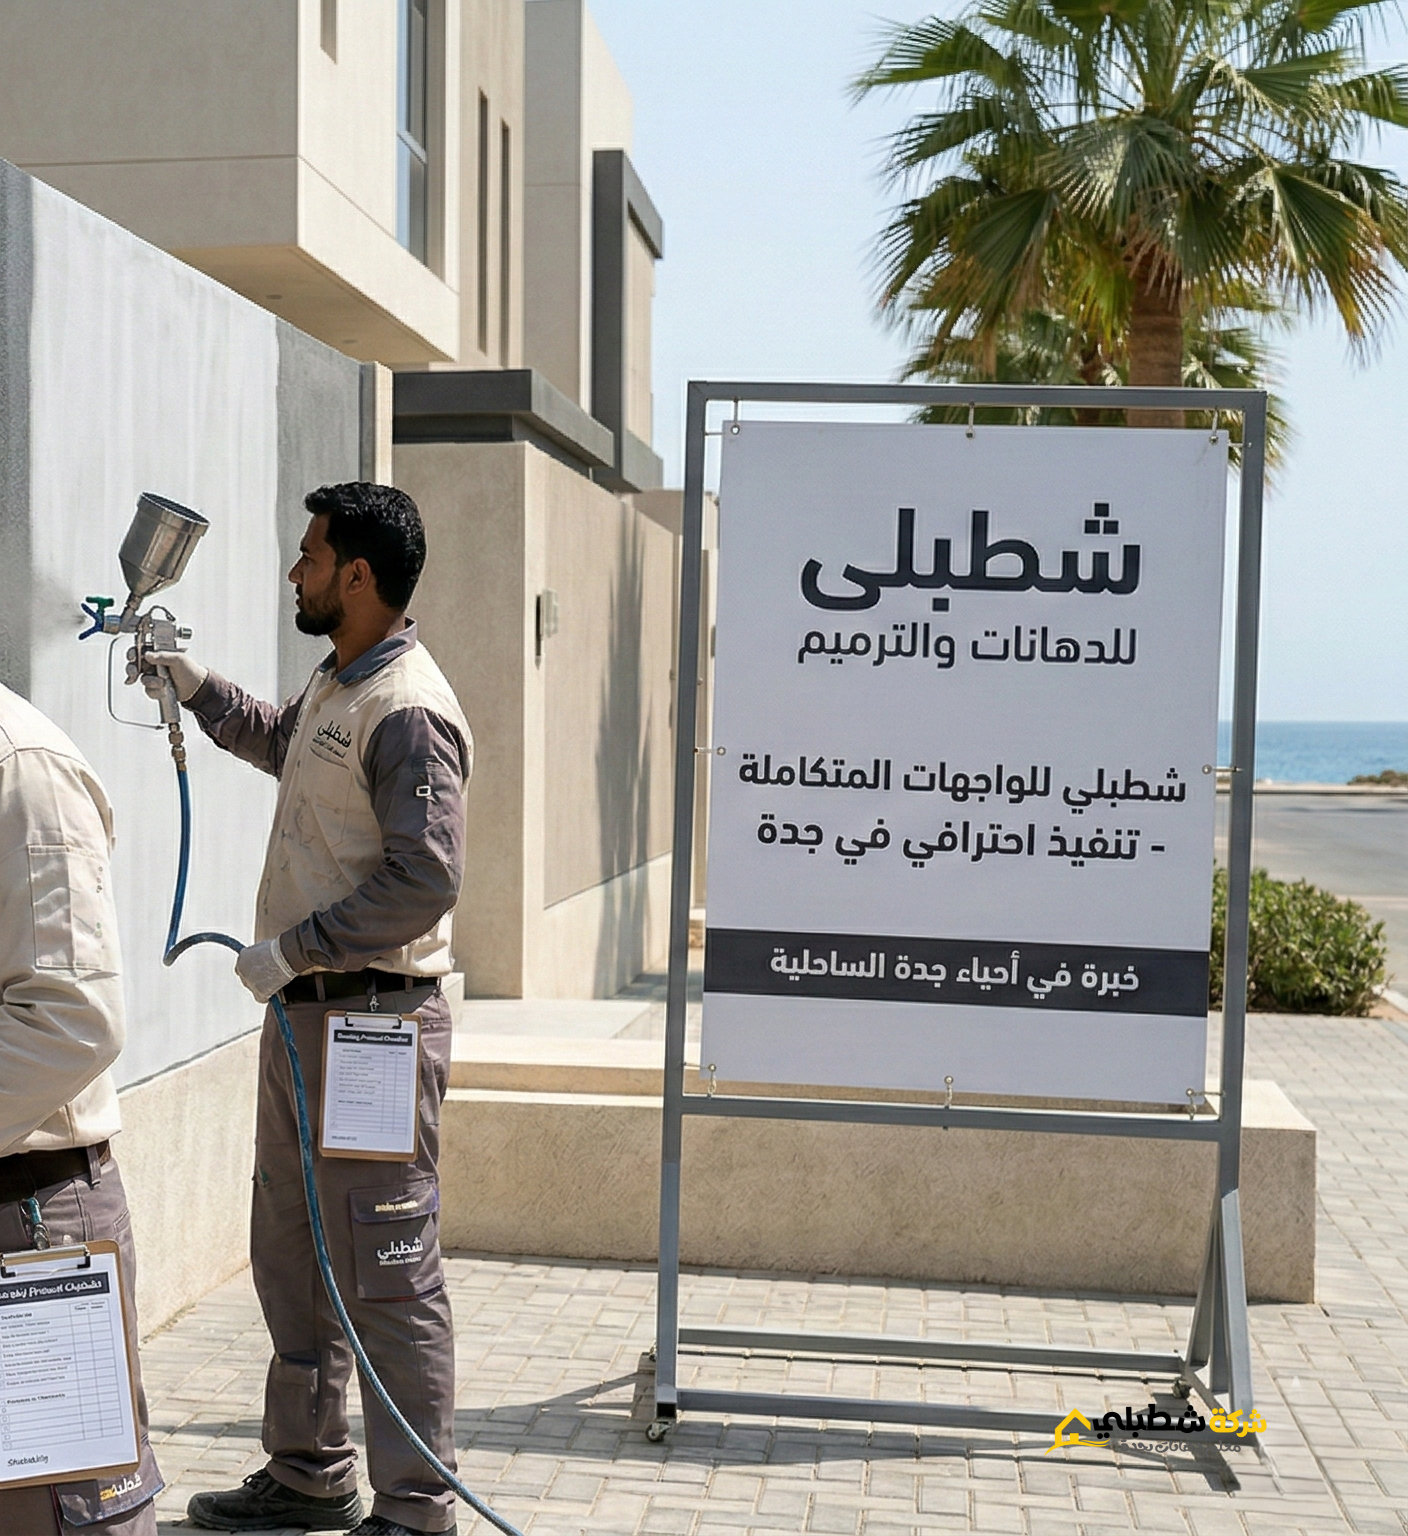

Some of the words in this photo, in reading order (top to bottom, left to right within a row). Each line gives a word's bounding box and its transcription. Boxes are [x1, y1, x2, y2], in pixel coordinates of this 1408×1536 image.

[798, 622, 955, 668] والترميم
[972, 626, 1136, 664] للدهانات
[740, 754, 891, 790] المتكاملة
[904, 762, 1050, 803] للواجهات
[1063, 768, 1185, 814] شطبلي
[758, 814, 823, 855] جدة
[836, 819, 890, 865] في
[903, 821, 1035, 868] احترافي
[1048, 826, 1140, 867] تنفيذ
[771, 948, 884, 981] الساحلية
[895, 955, 946, 987] جدة
[956, 950, 1019, 990] أحياء
[1027, 963, 1071, 999] في
[1082, 964, 1138, 996] خبرة
